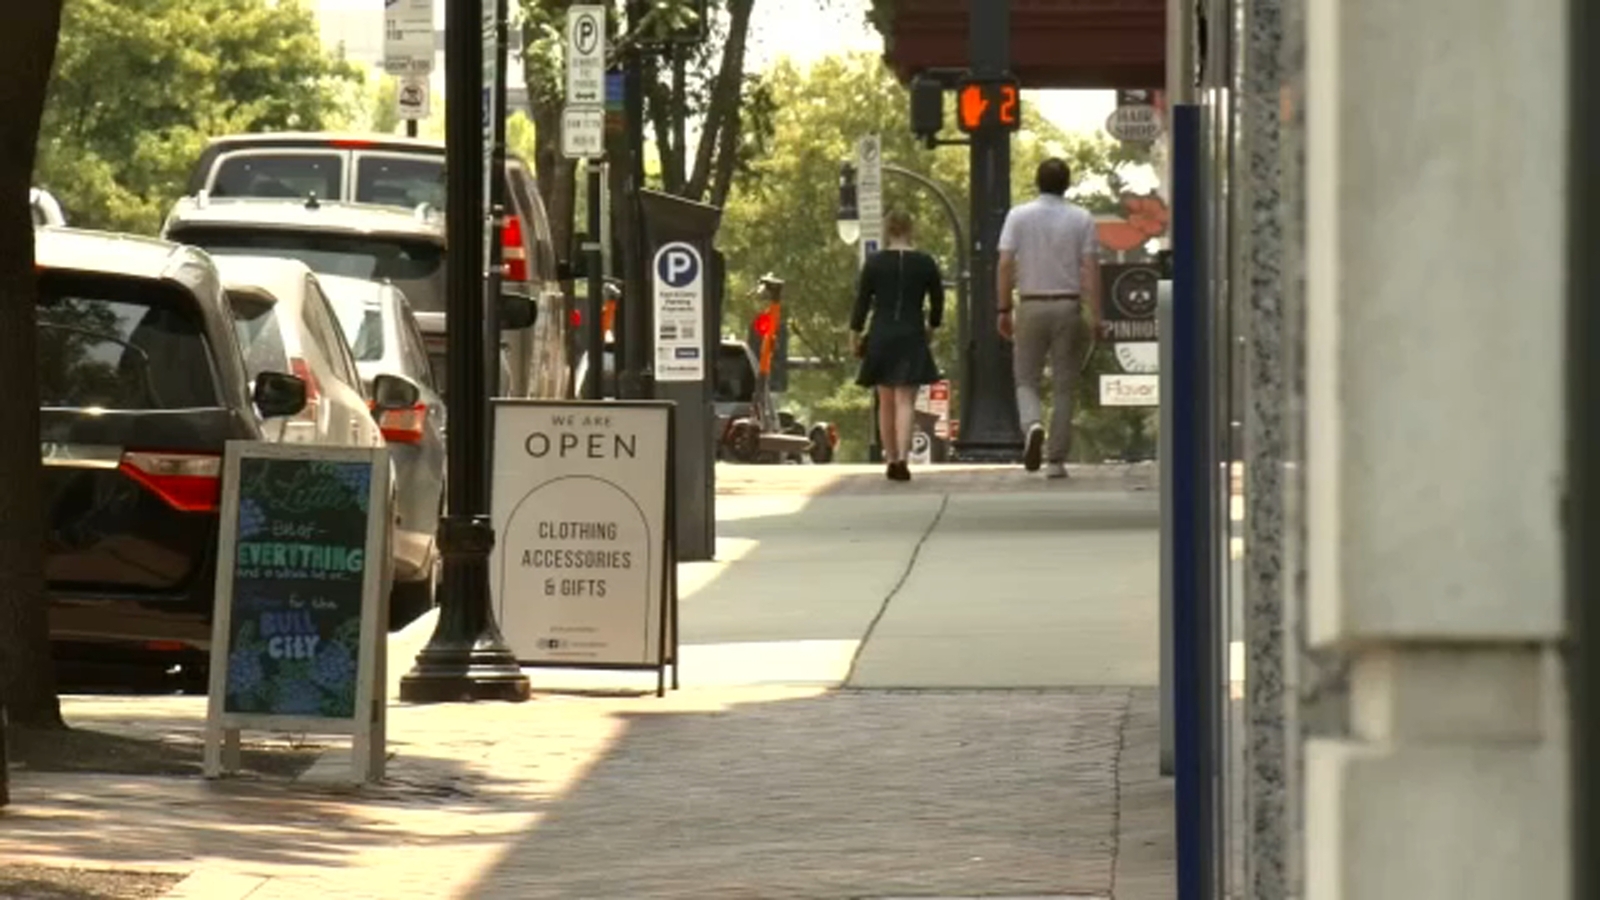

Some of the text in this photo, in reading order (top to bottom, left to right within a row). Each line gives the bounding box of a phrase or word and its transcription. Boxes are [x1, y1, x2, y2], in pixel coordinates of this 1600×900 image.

[581, 22, 593, 48] P
[1001, 87, 1016, 122] 2
[1117, 108, 1152, 122] HAIR
[1114, 124, 1157, 138] SHOP
[667, 252, 691, 283] P
[1105, 380, 1157, 396] Flavor
[552, 415, 613, 427] WE ARE
[525, 432, 636, 459] OPEN
[539, 522, 617, 540] CLOTHING
[238, 543, 363, 572] EVERYTHING
[521, 550, 632, 569] ACCESSORIES
[545, 578, 606, 597] & GIFTS
[261, 610, 317, 637] BULL
